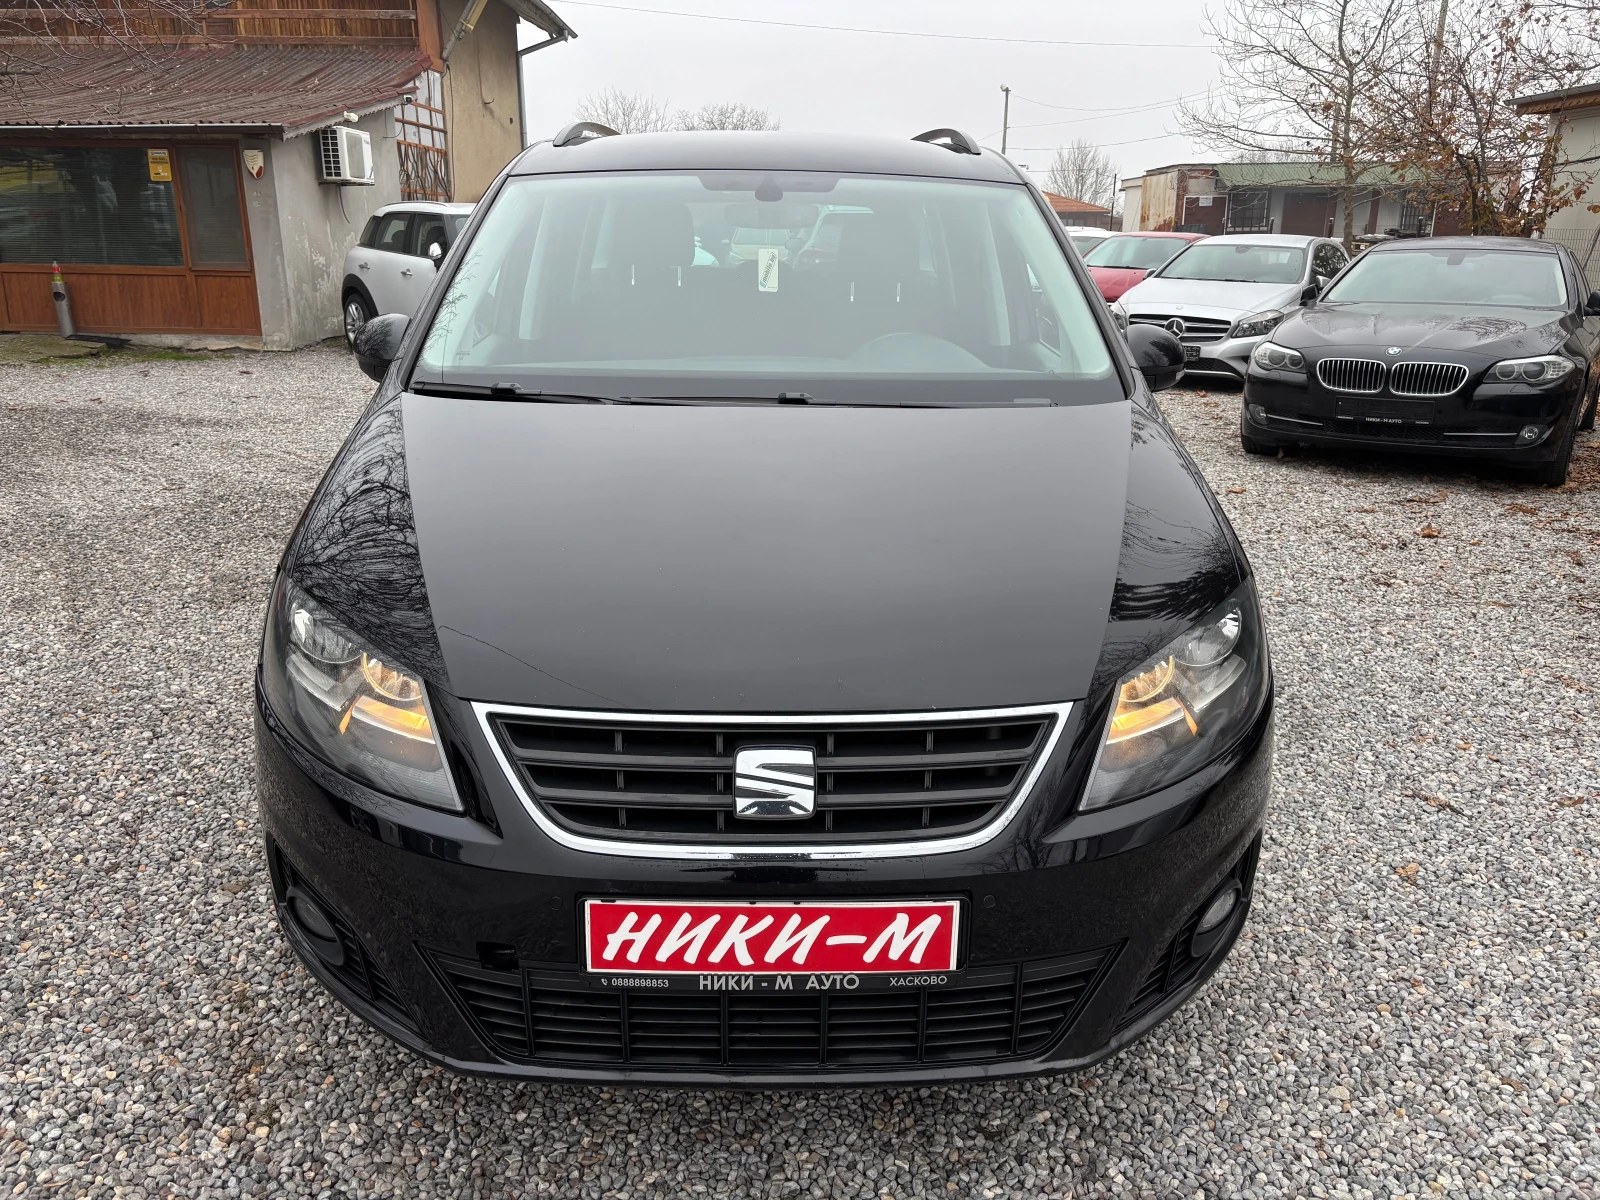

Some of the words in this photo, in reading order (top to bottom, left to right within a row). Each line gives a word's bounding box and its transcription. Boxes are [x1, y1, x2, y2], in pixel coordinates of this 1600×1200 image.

[602, 911, 942, 966] НИКИ-М
[611, 978, 669, 988] 0888898853
[699, 975, 754, 990] НИКИ
[774, 975, 794, 990] М
[805, 974, 860, 990] АУТО
[889, 975, 948, 987] ХАСКОВО
